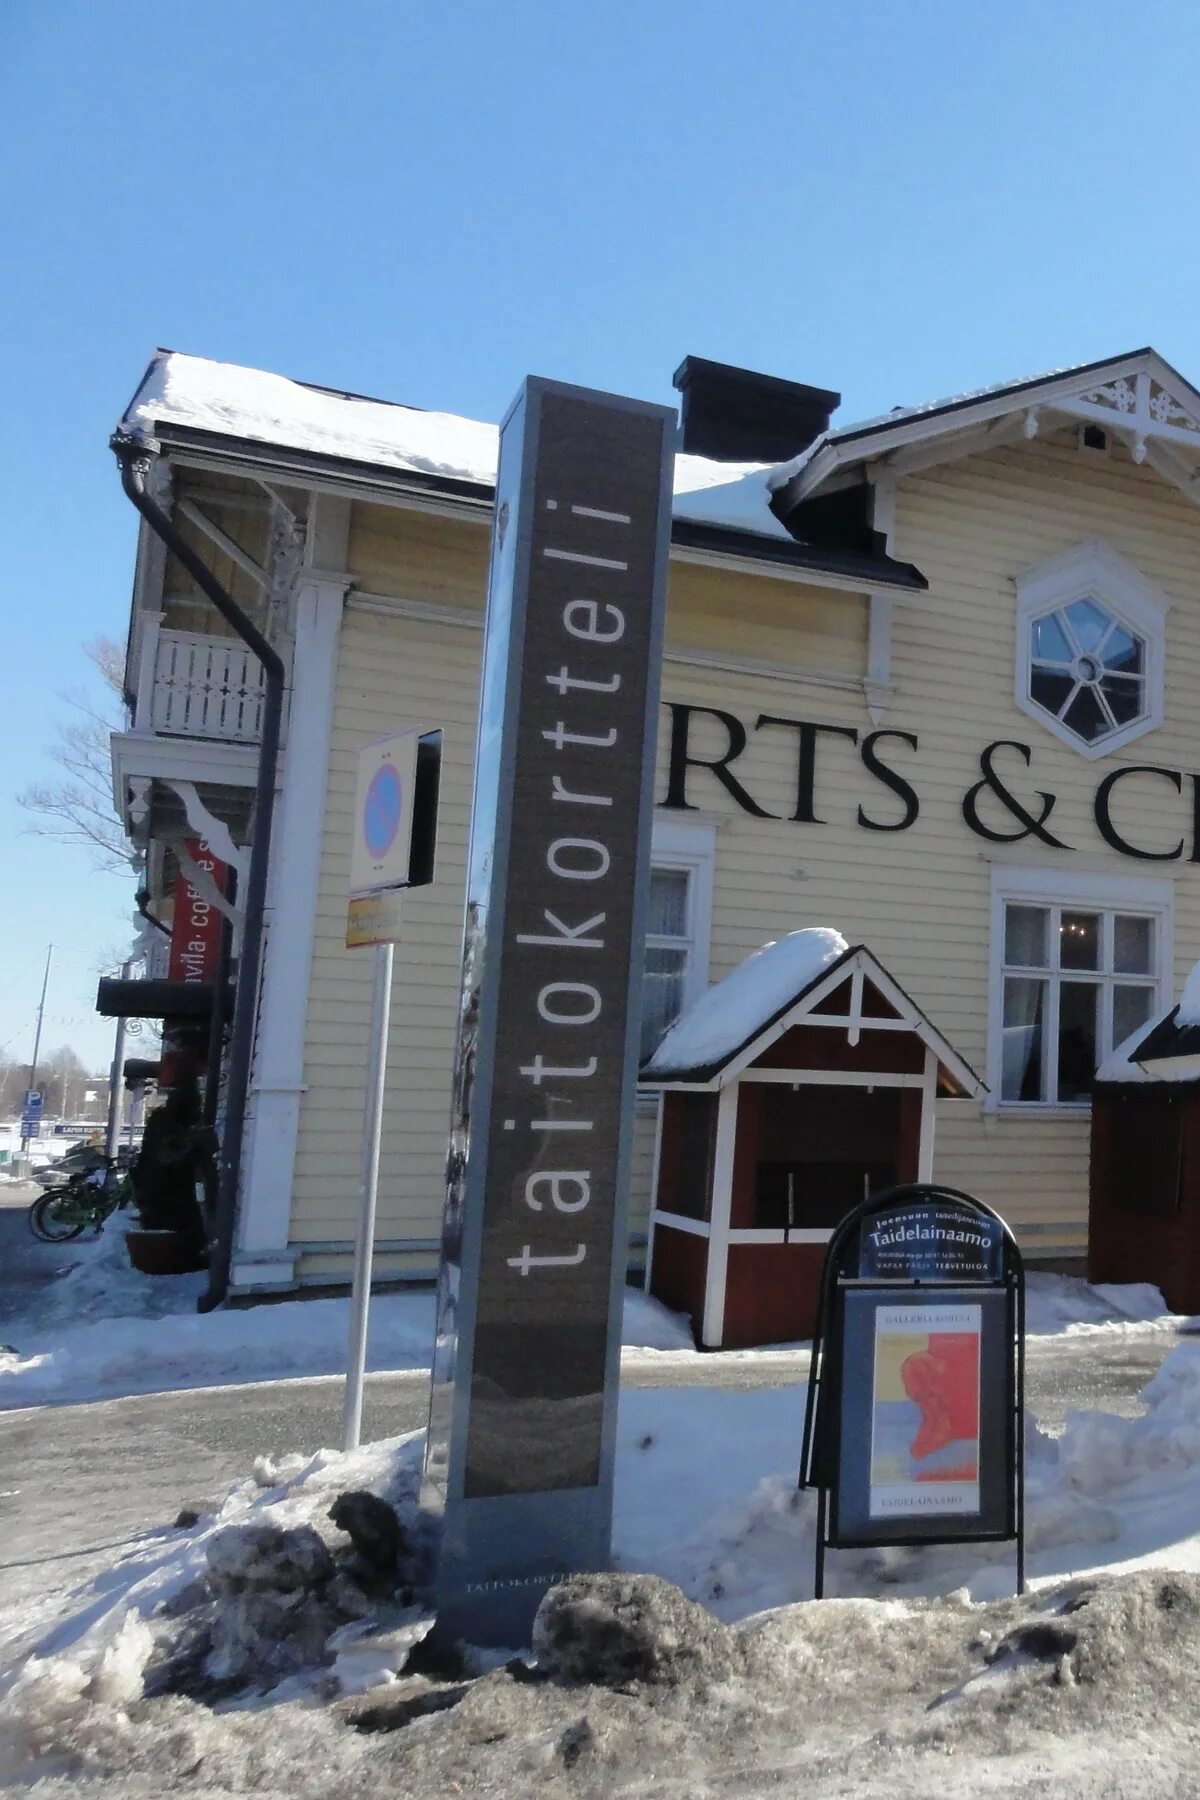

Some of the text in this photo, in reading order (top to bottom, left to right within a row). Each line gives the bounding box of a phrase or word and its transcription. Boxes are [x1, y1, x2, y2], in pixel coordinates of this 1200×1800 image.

[656, 701, 920, 832] RTS
[962, 740, 1077, 851] &
[503, 498, 632, 1277] taitokortteli
[869, 1223, 992, 1249] Taidelainaamo
